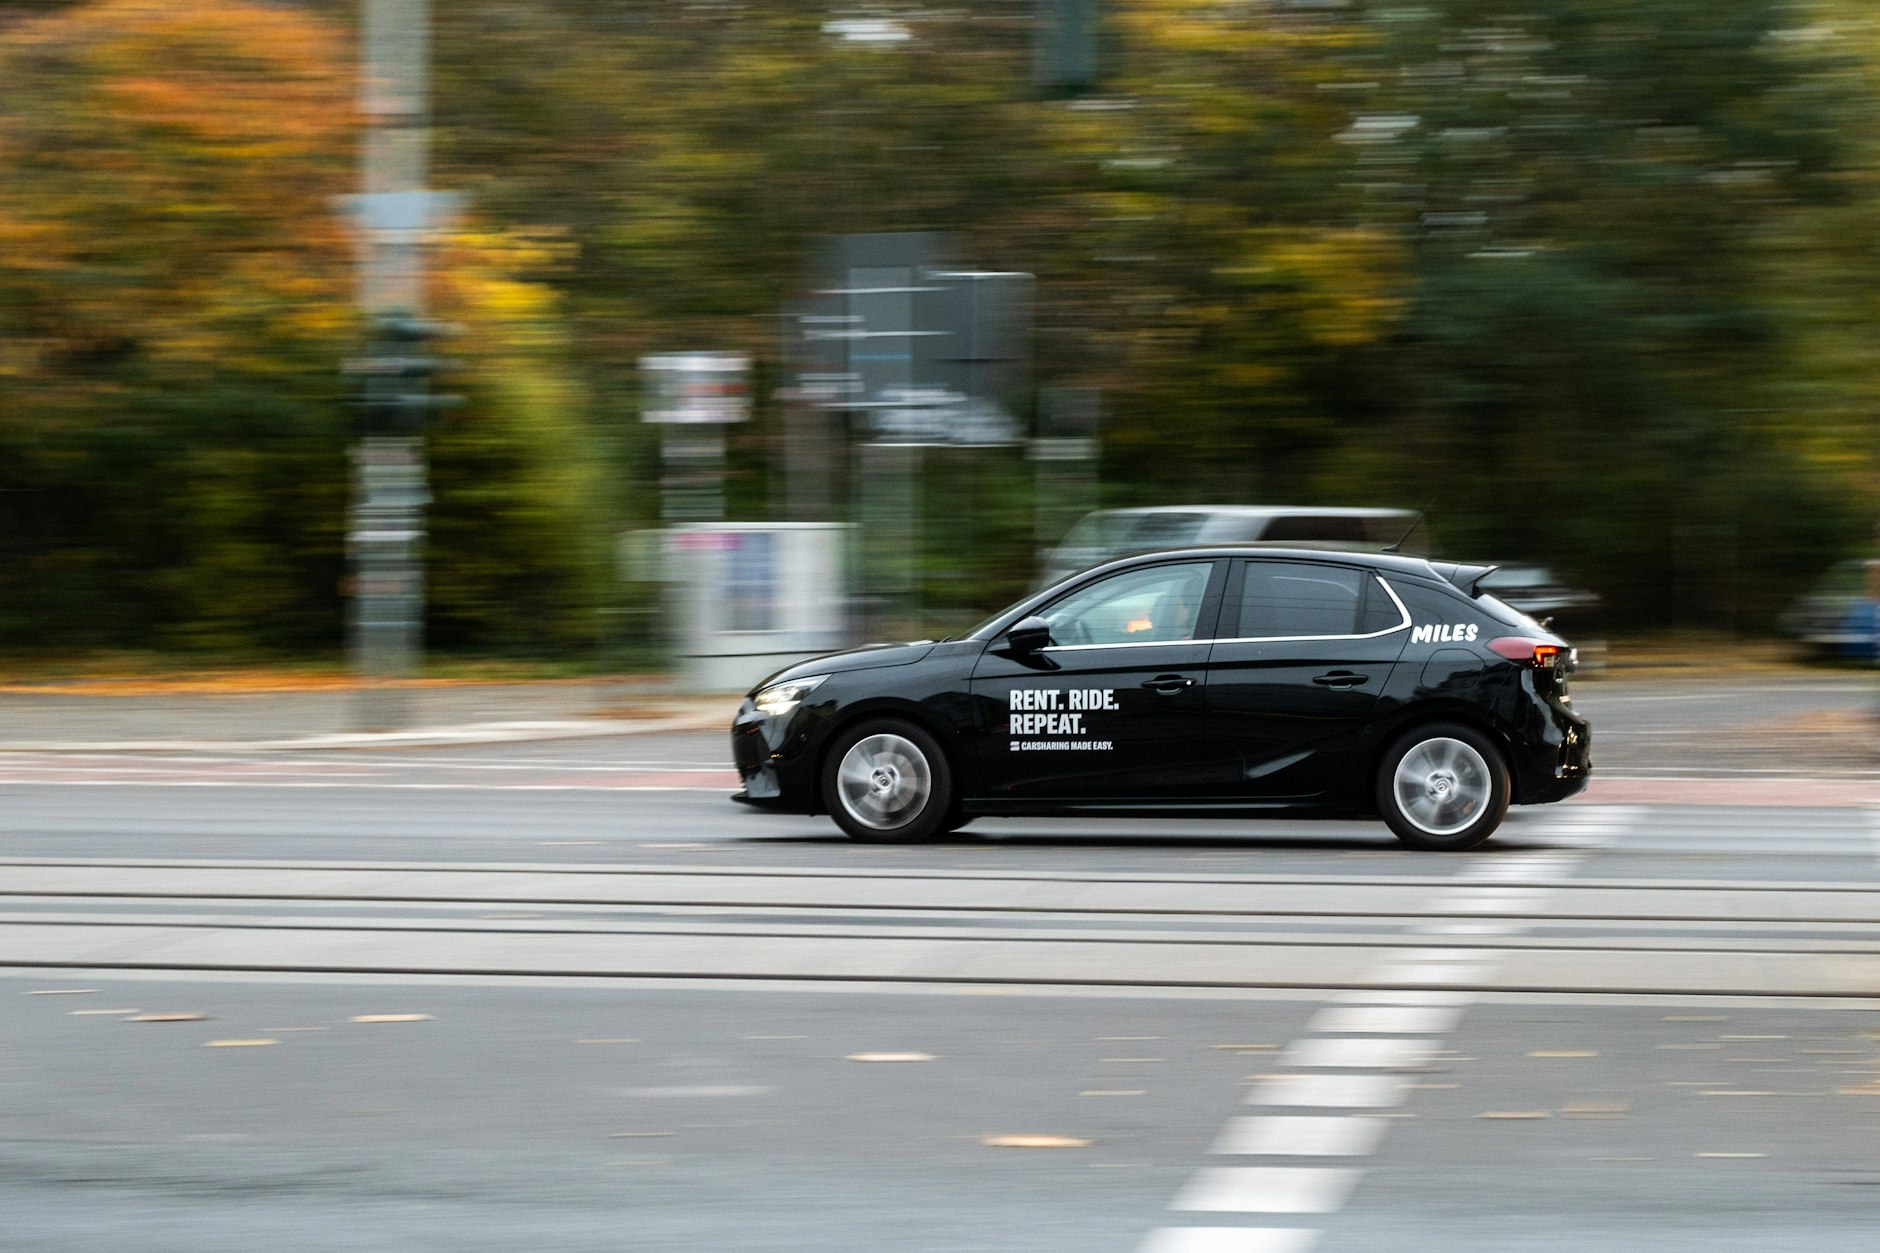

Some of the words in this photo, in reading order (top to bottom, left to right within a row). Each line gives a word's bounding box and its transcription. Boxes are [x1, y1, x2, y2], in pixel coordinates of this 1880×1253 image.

[1411, 623, 1479, 644] MILES
[1009, 689, 1065, 711] RENT.
[1068, 689, 1120, 711] RIDE.
[1009, 713, 1087, 735] REPEAT.
[1021, 741, 1070, 751] CARSHARING
[1070, 741, 1092, 751] MADE
[1093, 741, 1113, 751] EASY.
